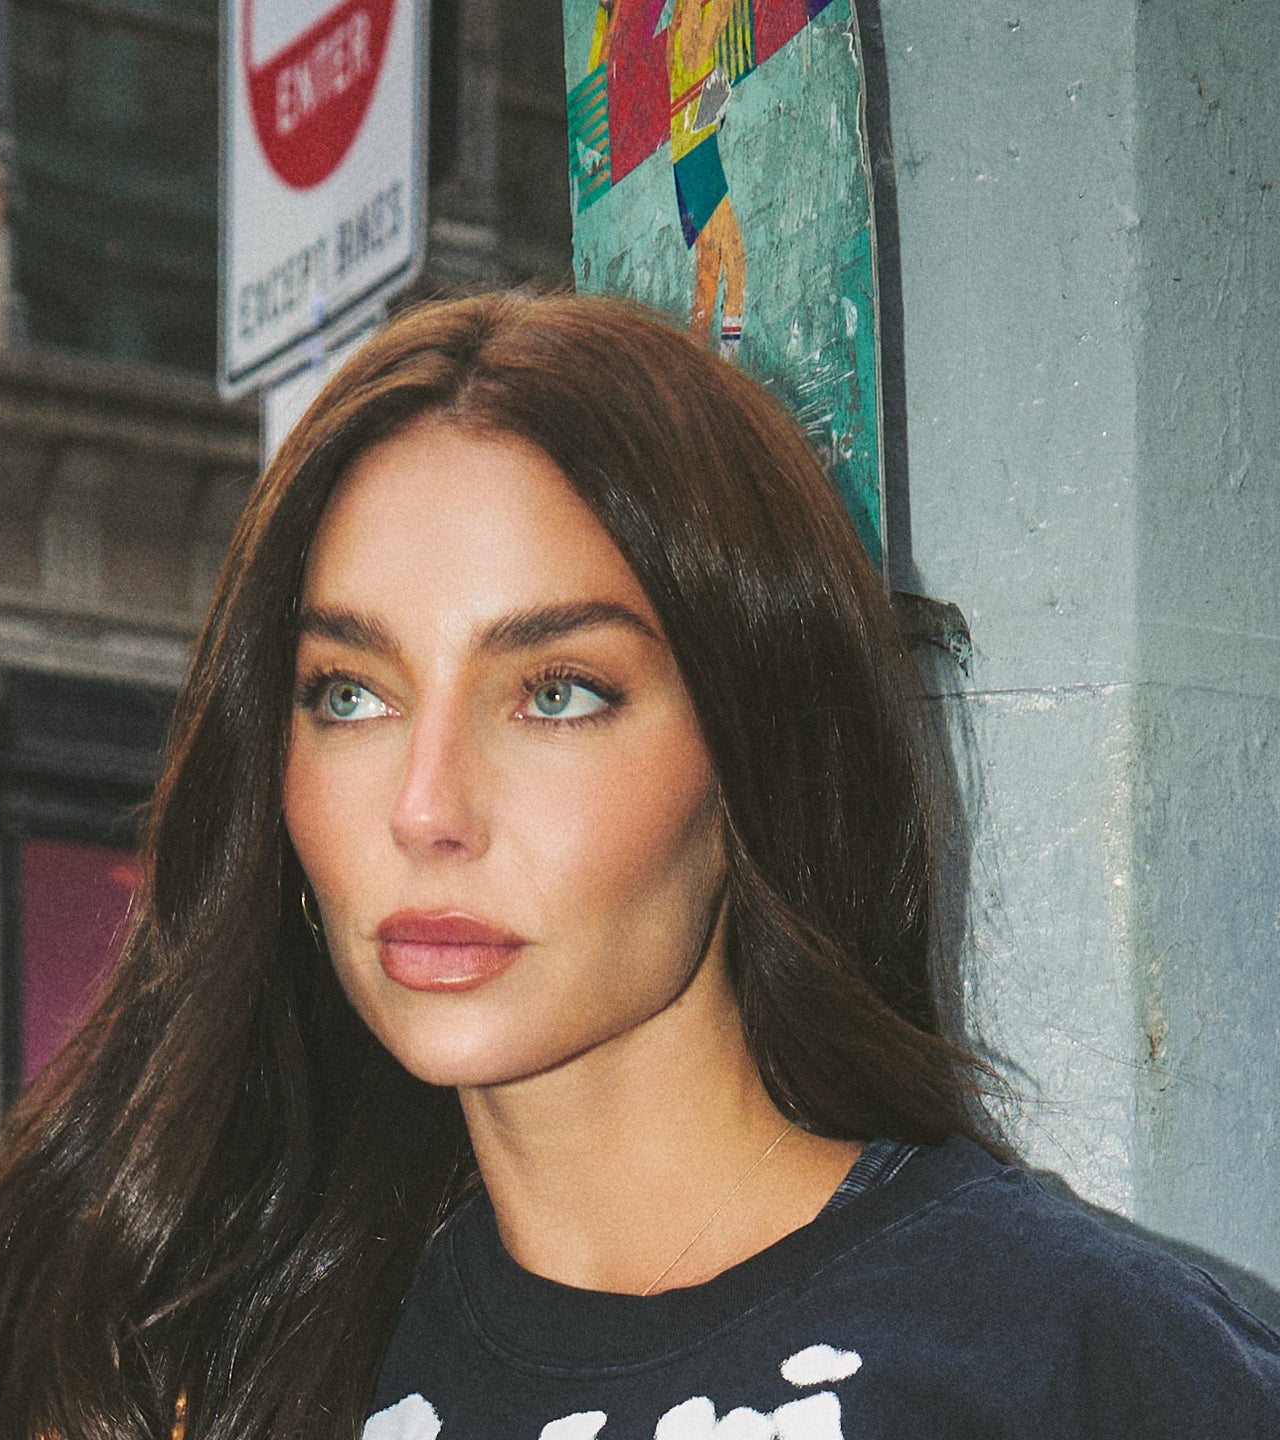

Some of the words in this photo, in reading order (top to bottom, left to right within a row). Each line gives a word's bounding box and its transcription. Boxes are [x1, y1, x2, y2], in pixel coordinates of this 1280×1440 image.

[274, 8, 372, 136] ENTER
[238, 235, 328, 339] EXCEPT
[335, 181, 404, 277] BIKES
